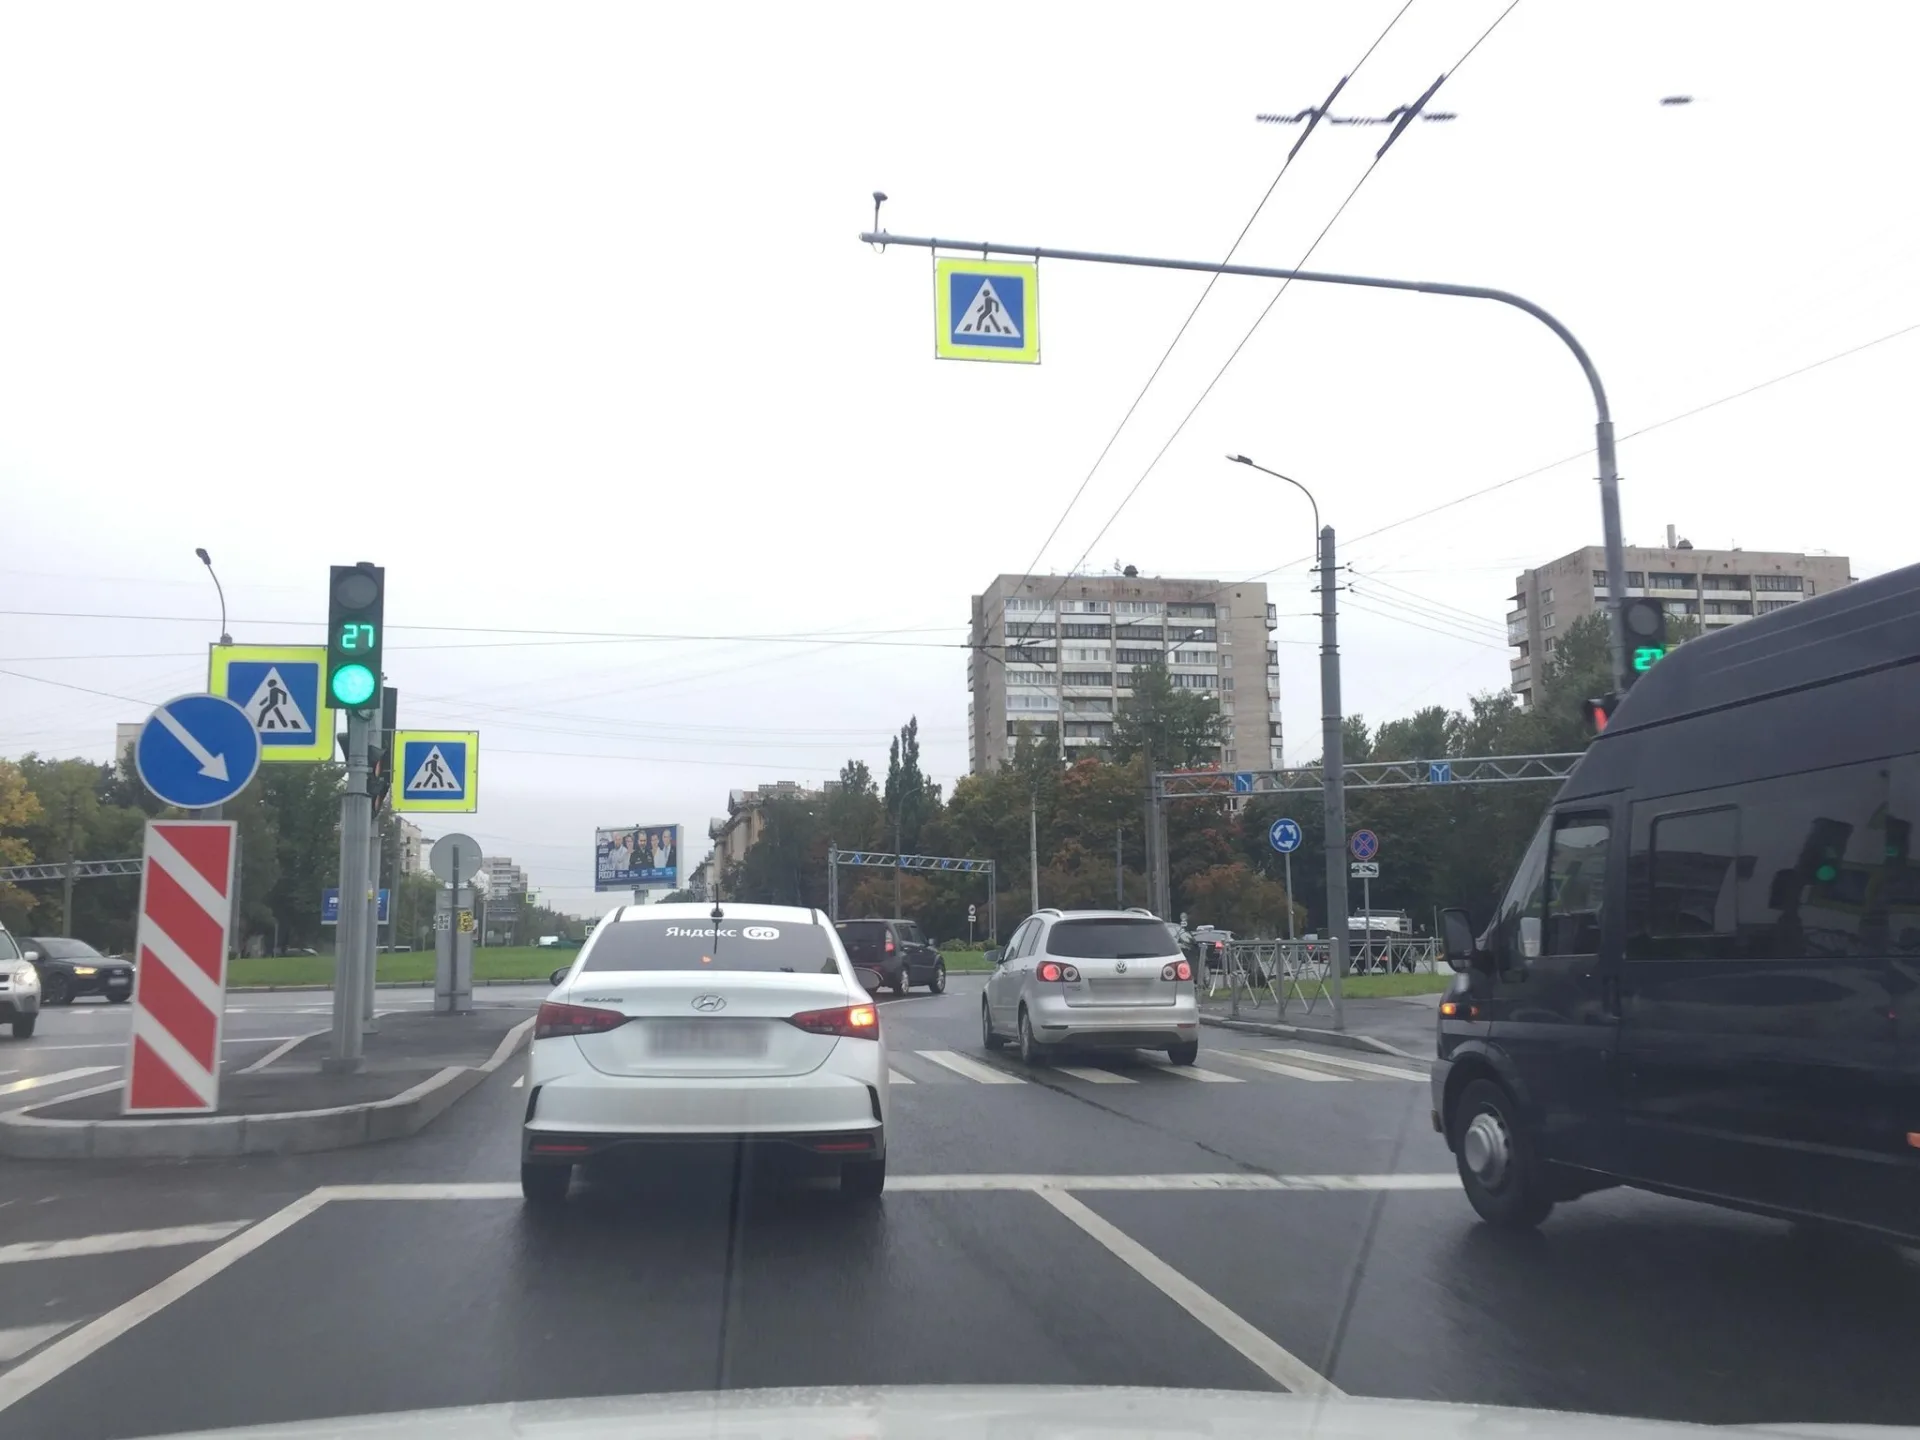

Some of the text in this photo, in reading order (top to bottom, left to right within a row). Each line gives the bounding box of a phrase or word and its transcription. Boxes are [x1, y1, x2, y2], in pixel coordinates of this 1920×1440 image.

[342, 624, 374, 648] 27
[1634, 648, 1664, 670] 27
[665, 926, 777, 938] Яндекс Go
